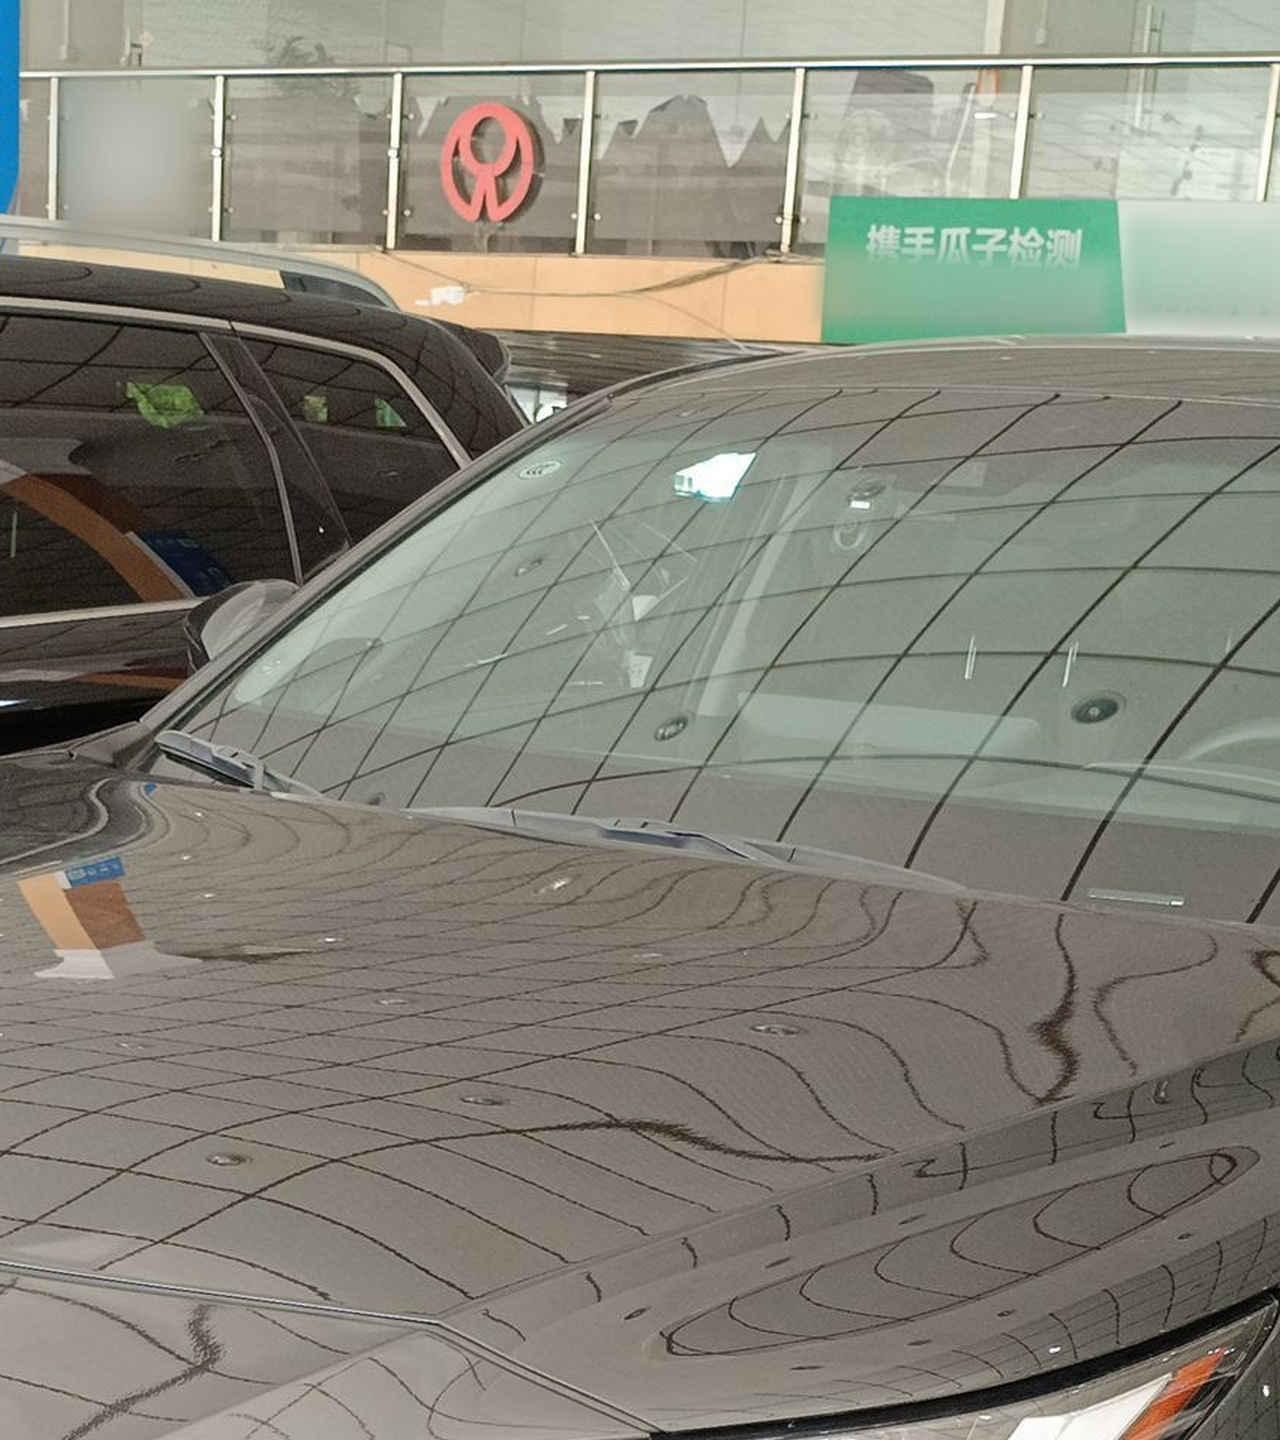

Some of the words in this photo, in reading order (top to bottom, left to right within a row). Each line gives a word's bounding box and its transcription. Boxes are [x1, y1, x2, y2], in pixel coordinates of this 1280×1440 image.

[867, 224, 1083, 267] 携手瓜子检测
